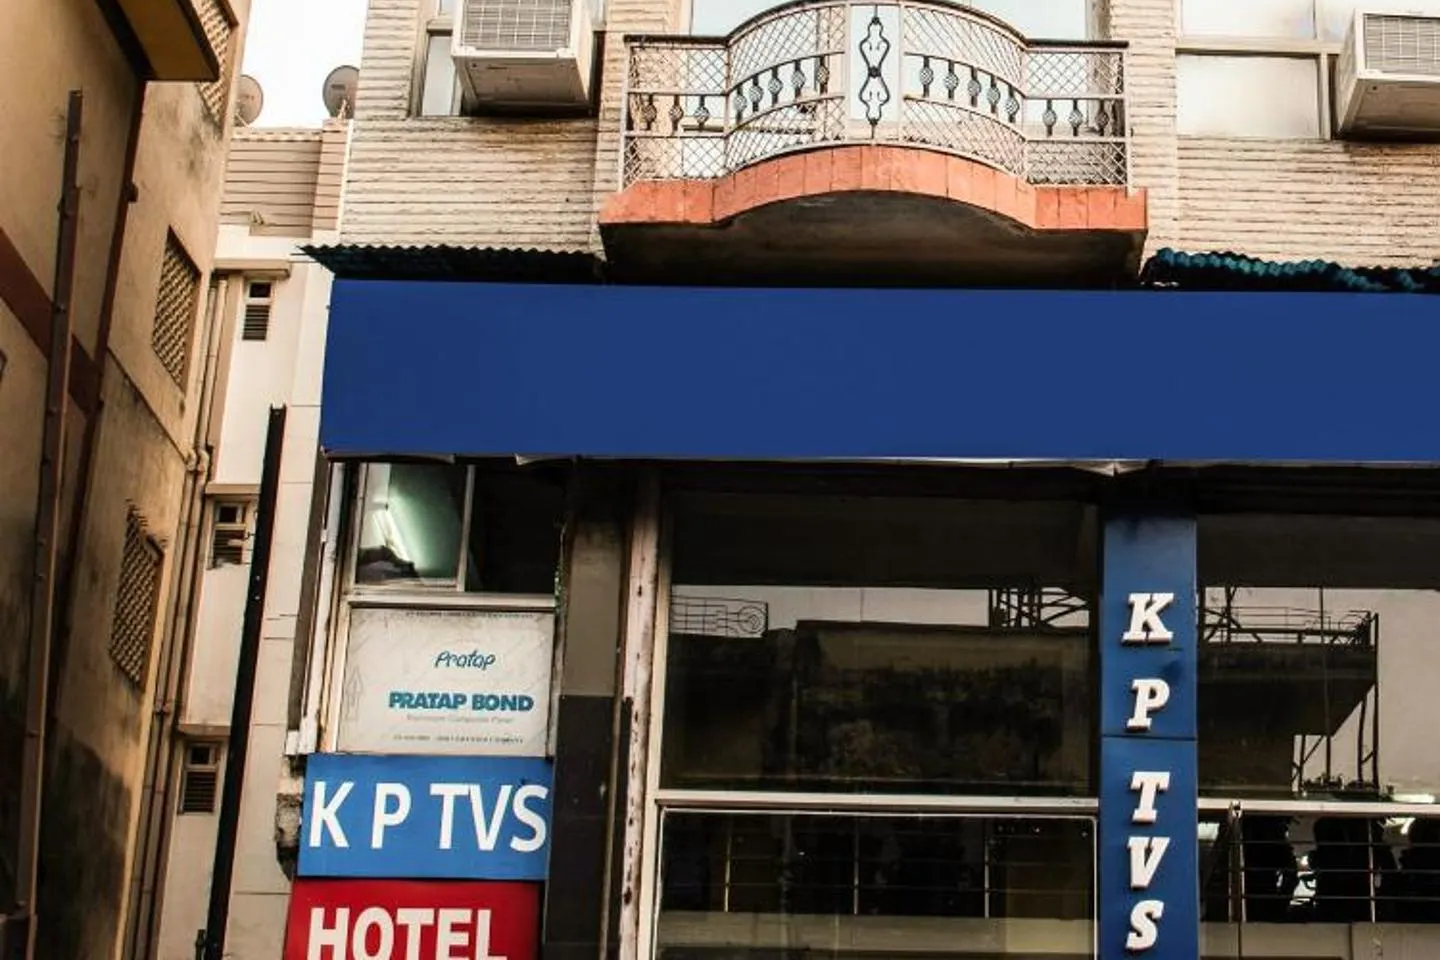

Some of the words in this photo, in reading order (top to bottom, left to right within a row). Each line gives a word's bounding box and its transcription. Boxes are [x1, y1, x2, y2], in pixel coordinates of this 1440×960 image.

[434, 650, 496, 671] Pratap
[389, 692, 467, 710] PRATAP
[471, 694, 534, 712] BOND
[309, 781, 354, 848] K
[371, 783, 411, 849] P
[430, 783, 548, 852] TVS
[307, 907, 507, 960] HOTEL
